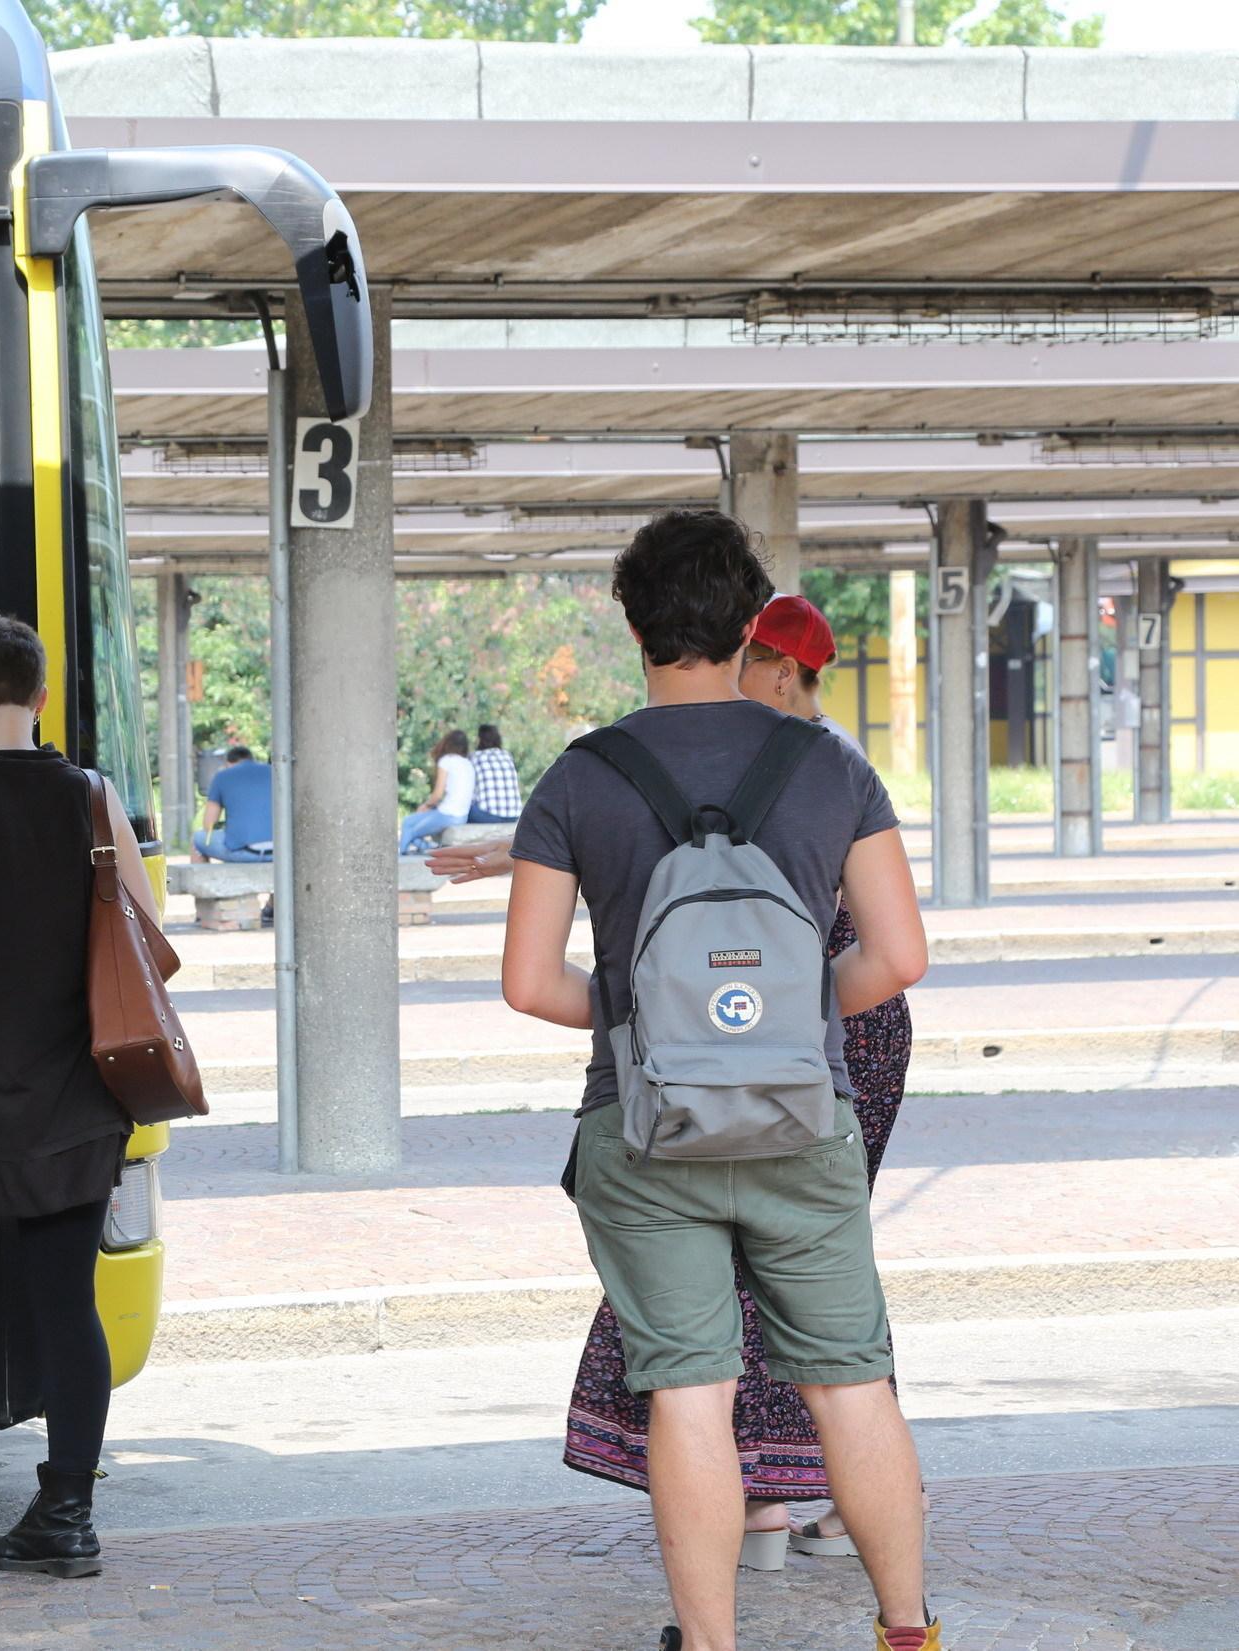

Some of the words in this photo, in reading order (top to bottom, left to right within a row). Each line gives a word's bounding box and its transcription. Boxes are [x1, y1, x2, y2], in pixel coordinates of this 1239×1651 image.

[299, 423, 353, 523] 3
[939, 571, 966, 611] 5
[1142, 617, 1156, 645] 7
